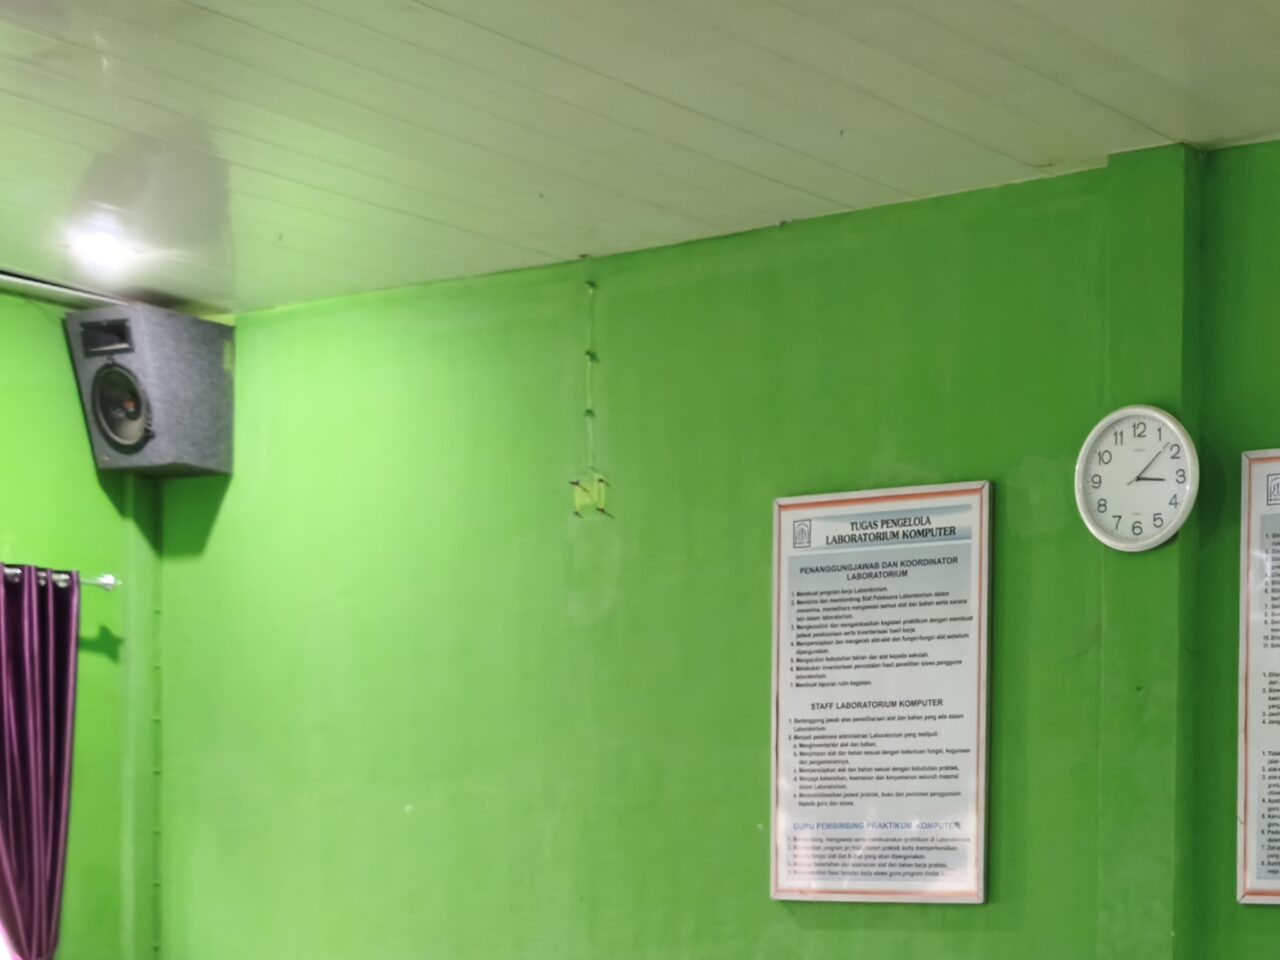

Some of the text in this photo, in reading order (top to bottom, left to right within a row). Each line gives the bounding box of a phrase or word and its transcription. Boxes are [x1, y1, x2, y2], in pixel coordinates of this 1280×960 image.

[1114, 430, 1124, 445] 11
[1132, 422, 1146, 438] 12
[1157, 427, 1162, 441] 1
[1098, 450, 1112, 465] 10
[1170, 444, 1181, 459] 2
[1091, 474, 1102, 489] 9
[1176, 469, 1186, 484] 3
[1097, 498, 1107, 513] 8
[1169, 494, 1180, 508] 4
[850, 516, 932, 531] TUGAS PENGELOLA
[1112, 515, 1122, 530] 7
[1153, 513, 1164, 528] 5
[826, 526, 956, 545] LABORATORIUM KOMPUTER
[1132, 521, 1143, 536] 6
[800, 556, 958, 574] PENANGGUNGJAWAB DAN KOORDINATOR
[846, 570, 908, 581] LABORATORIUM
[811, 699, 943, 710] STAFF LABORATORIUM KOMPUTER
